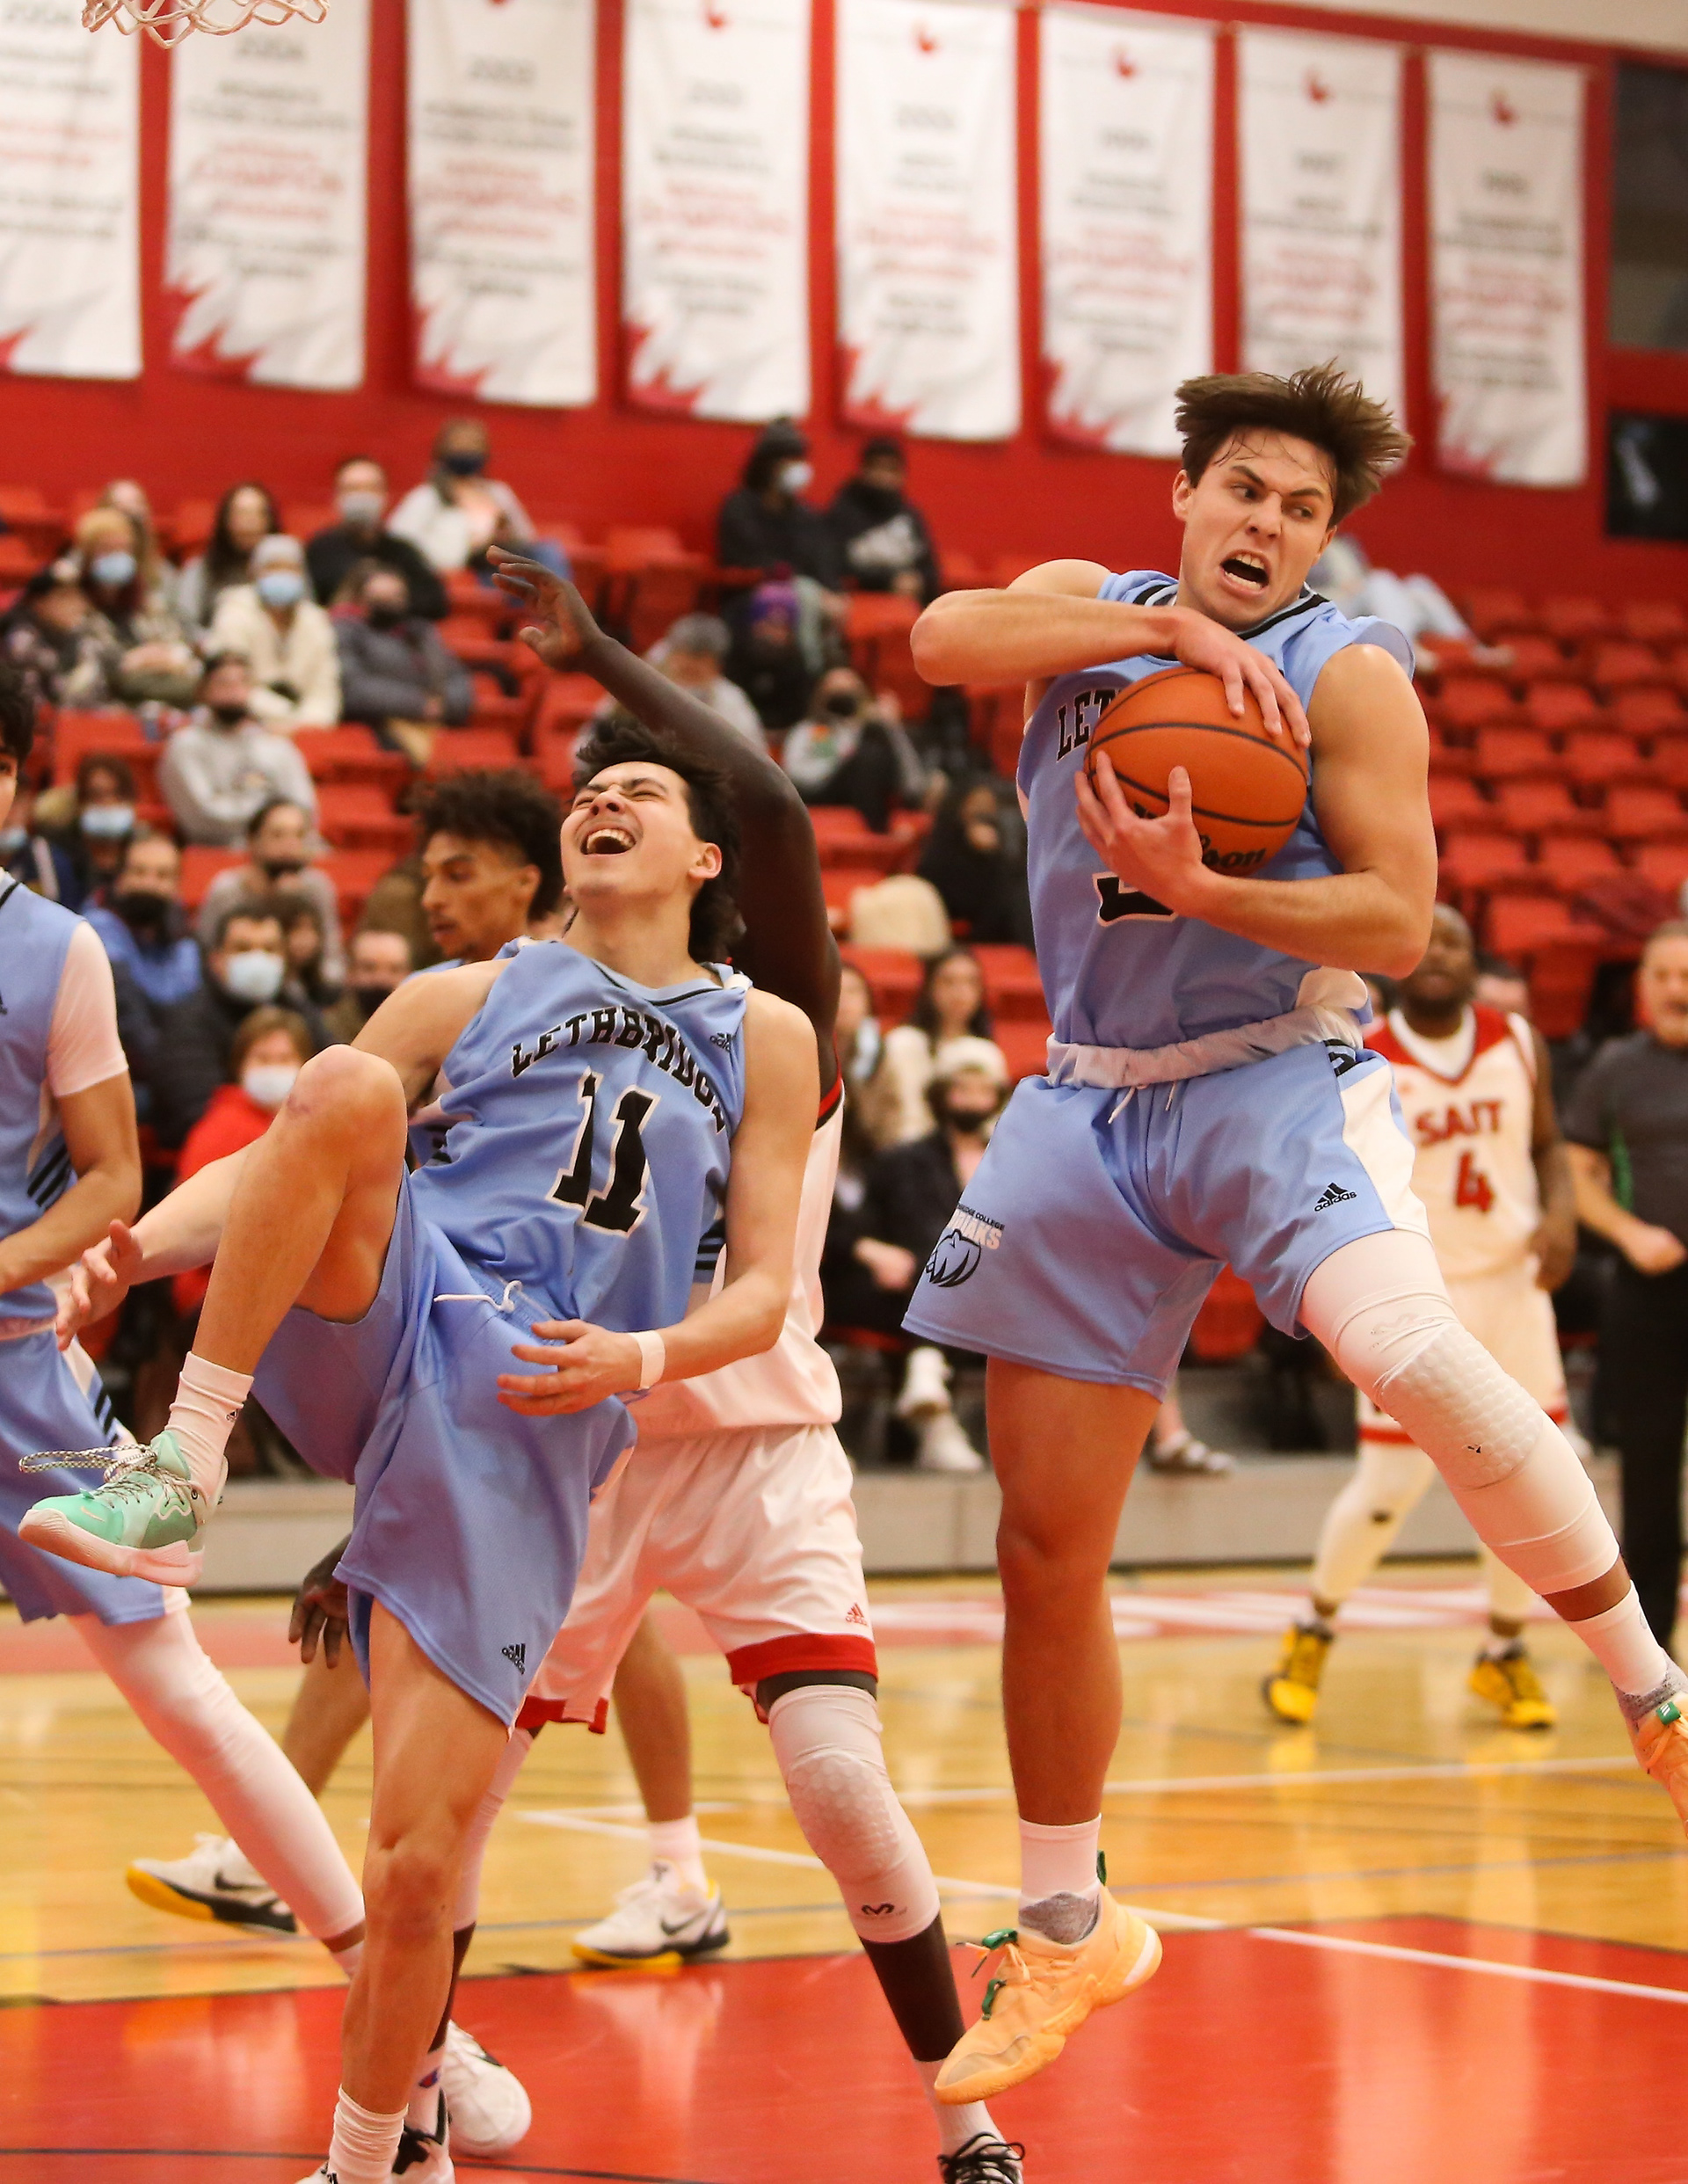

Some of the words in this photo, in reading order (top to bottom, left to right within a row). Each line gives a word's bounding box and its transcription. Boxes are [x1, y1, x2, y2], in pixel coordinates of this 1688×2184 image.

[1415, 1099, 1502, 1149] SAIT
[545, 1066, 661, 1239] 11
[1313, 1191, 1357, 1212] adidas
[1455, 1148, 1495, 1213] 4
[975, 1212, 1006, 1232] COLLEGE
